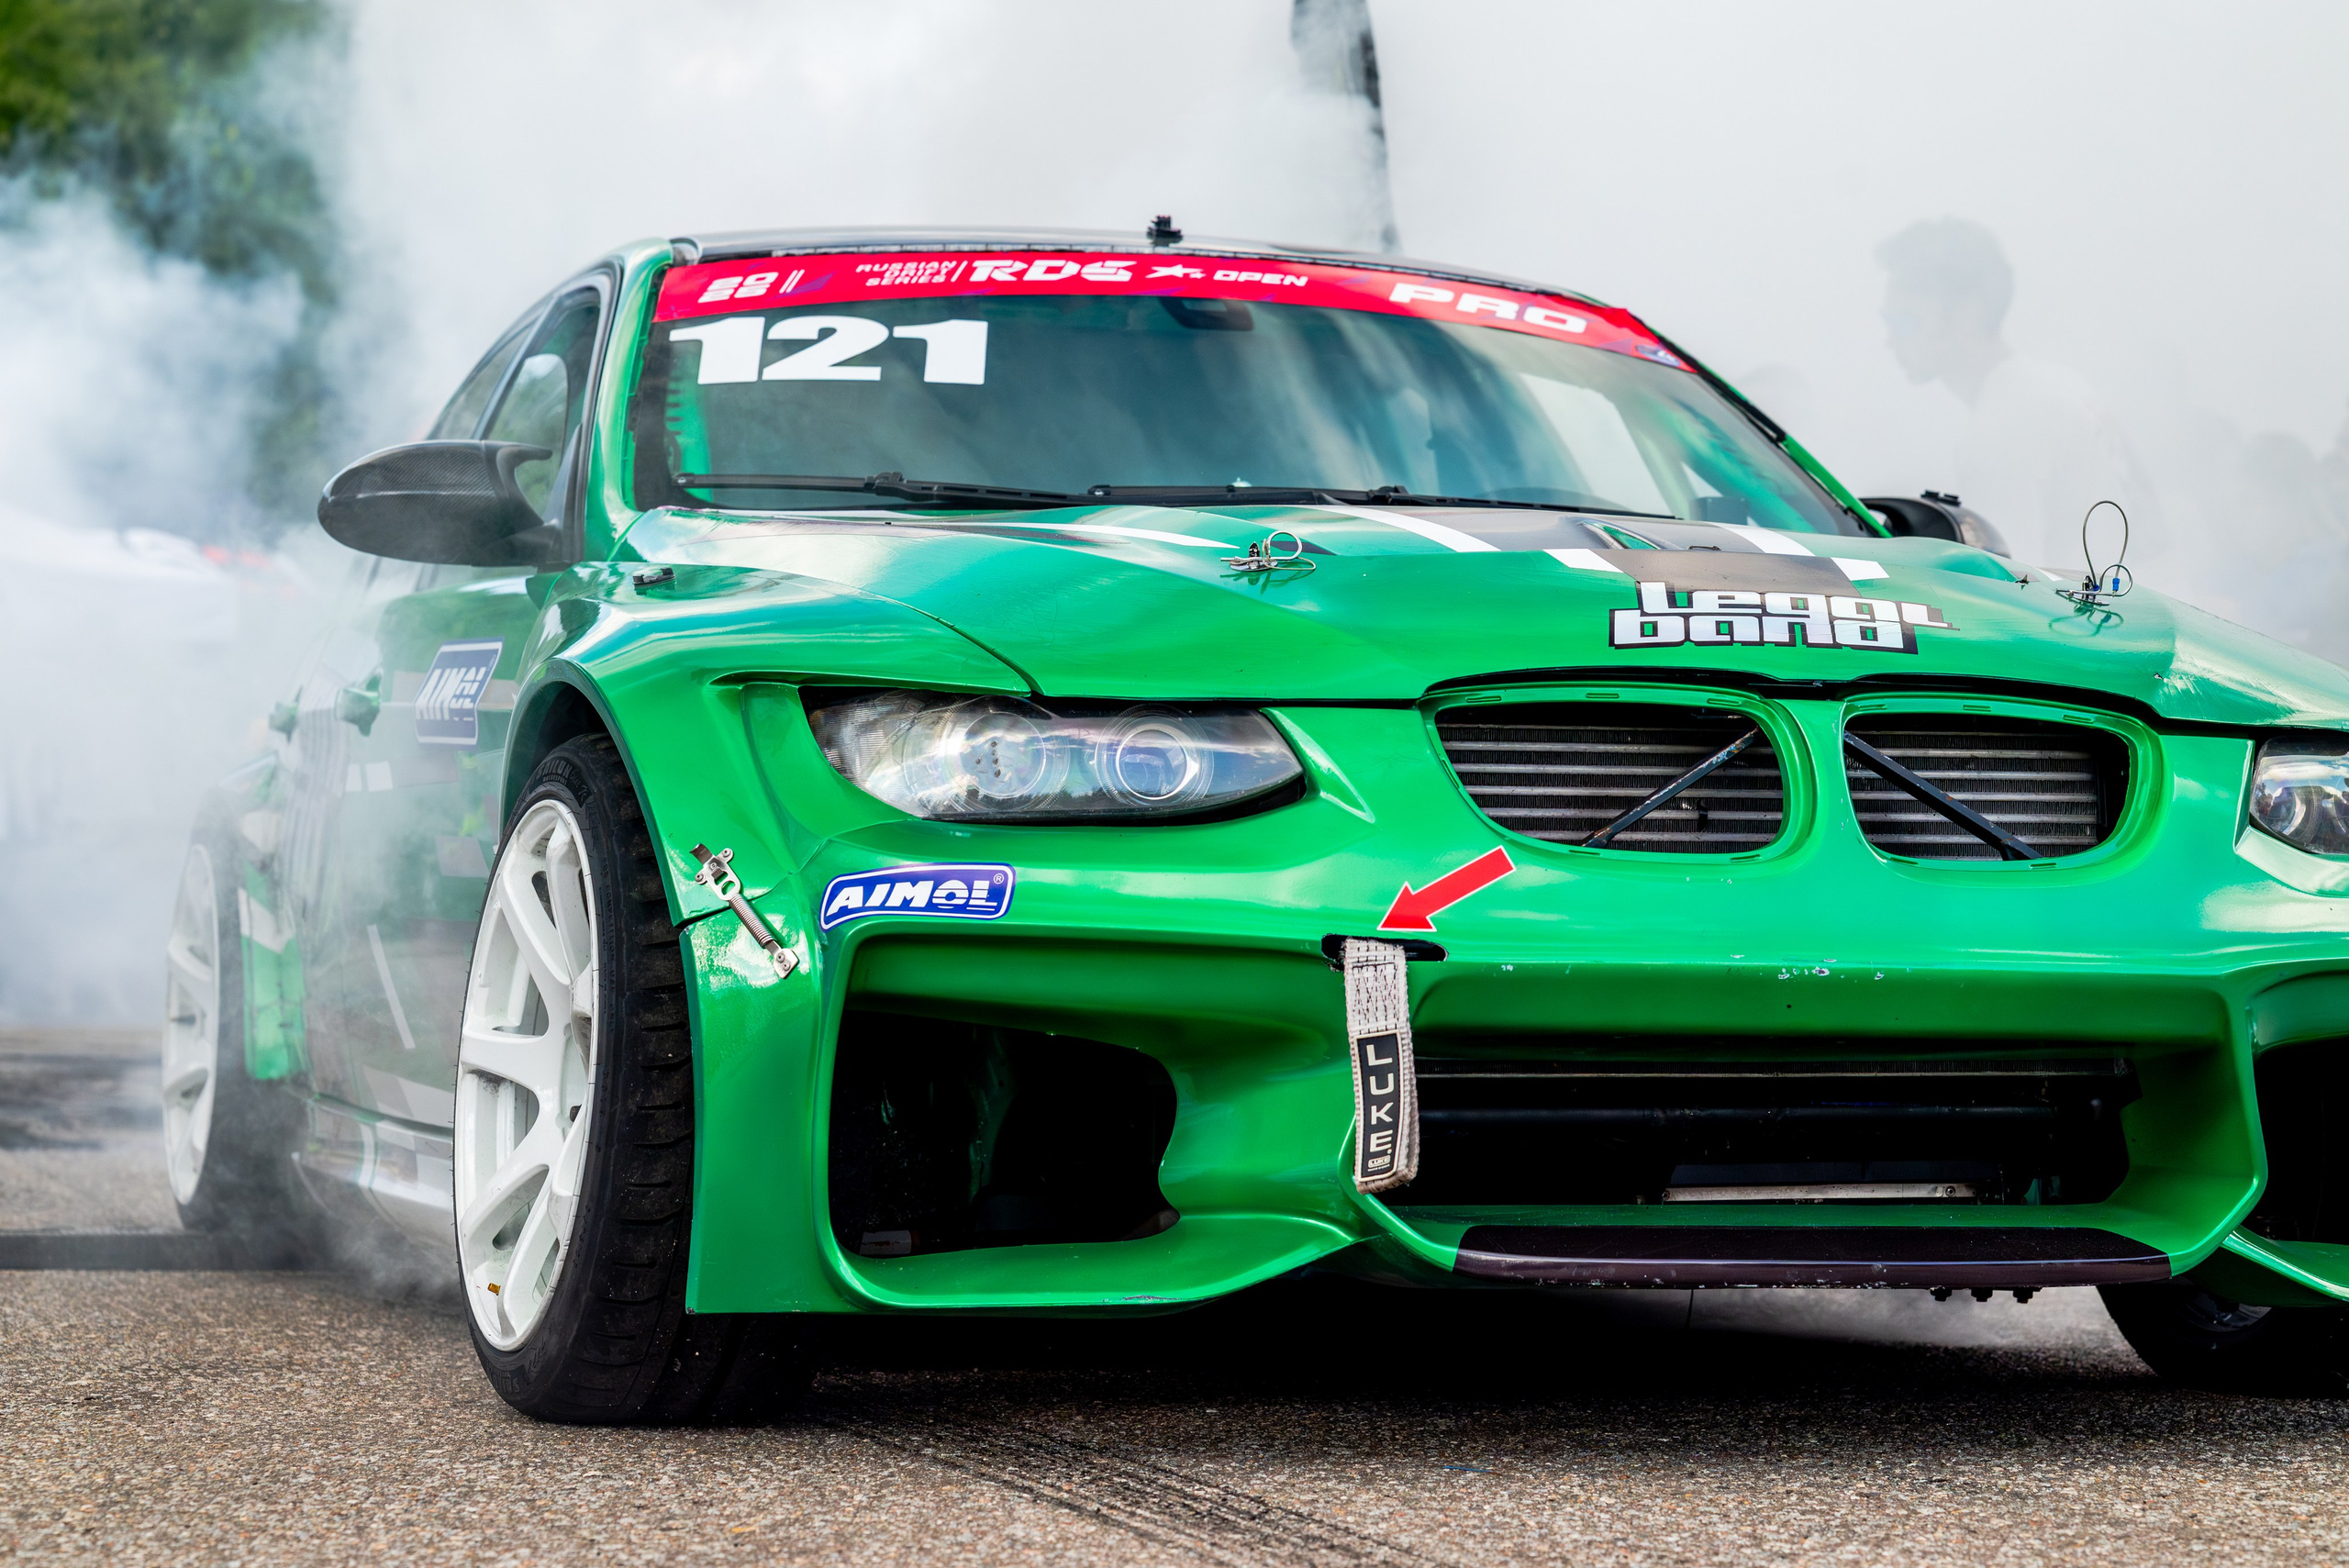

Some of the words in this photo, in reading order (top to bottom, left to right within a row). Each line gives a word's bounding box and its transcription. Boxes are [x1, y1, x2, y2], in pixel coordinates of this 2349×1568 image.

[855, 261, 957, 273] RUSSIAN
[865, 274, 947, 286] SERIES
[969, 260, 1137, 282] RDS
[1213, 270, 1308, 287] OPEN
[1388, 283, 1588, 335] PRO
[669, 315, 989, 385] 121
[1366, 1043, 1395, 1151] LUKE
